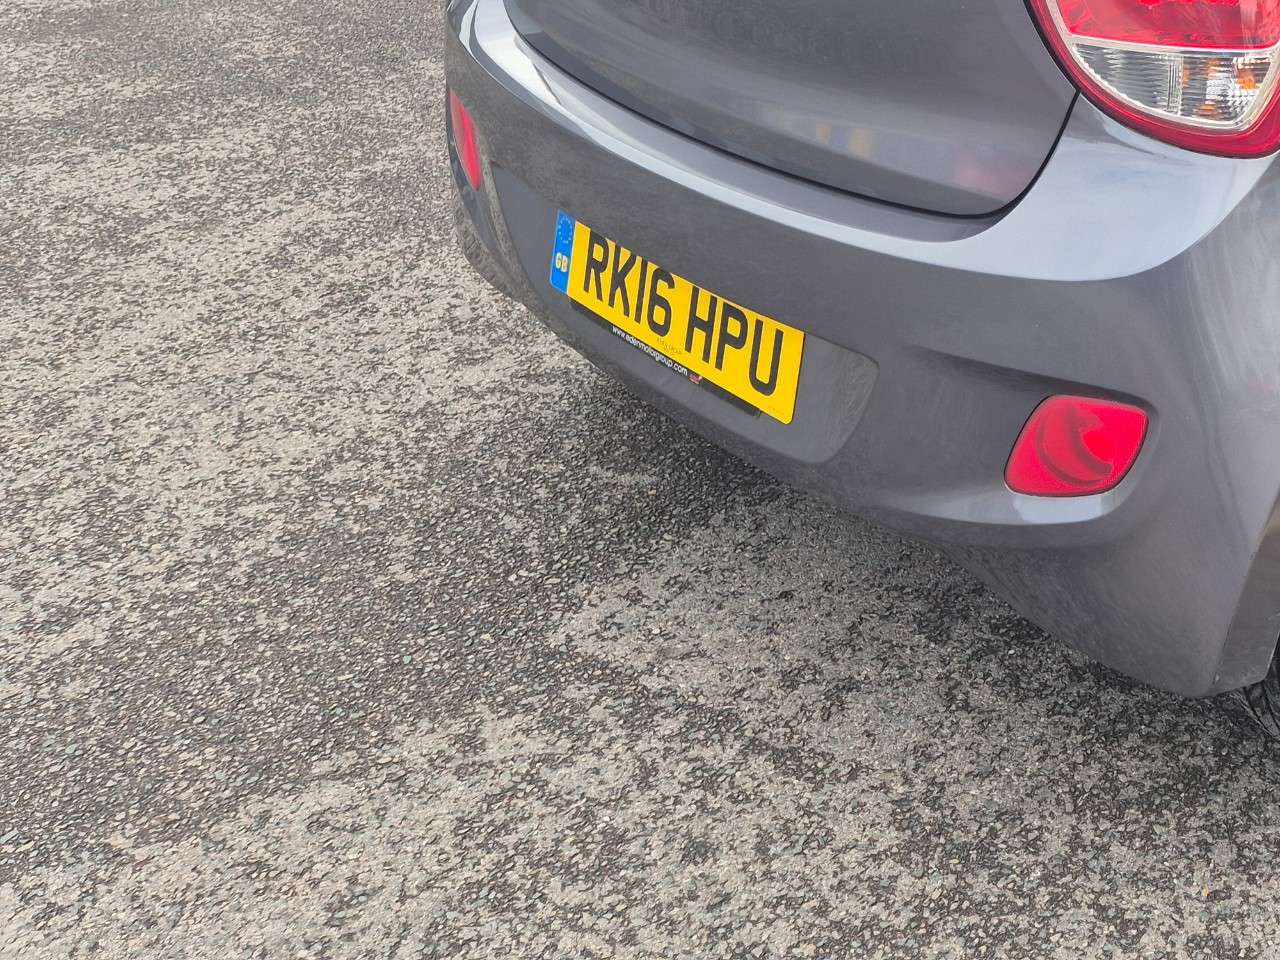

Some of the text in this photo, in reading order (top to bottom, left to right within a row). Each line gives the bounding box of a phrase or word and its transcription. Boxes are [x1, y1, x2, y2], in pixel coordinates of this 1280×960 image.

[555, 251, 569, 273] GB
[584, 229, 785, 396] RK16 HPU
[612, 324, 689, 377] www.edenmotorgroup.com
